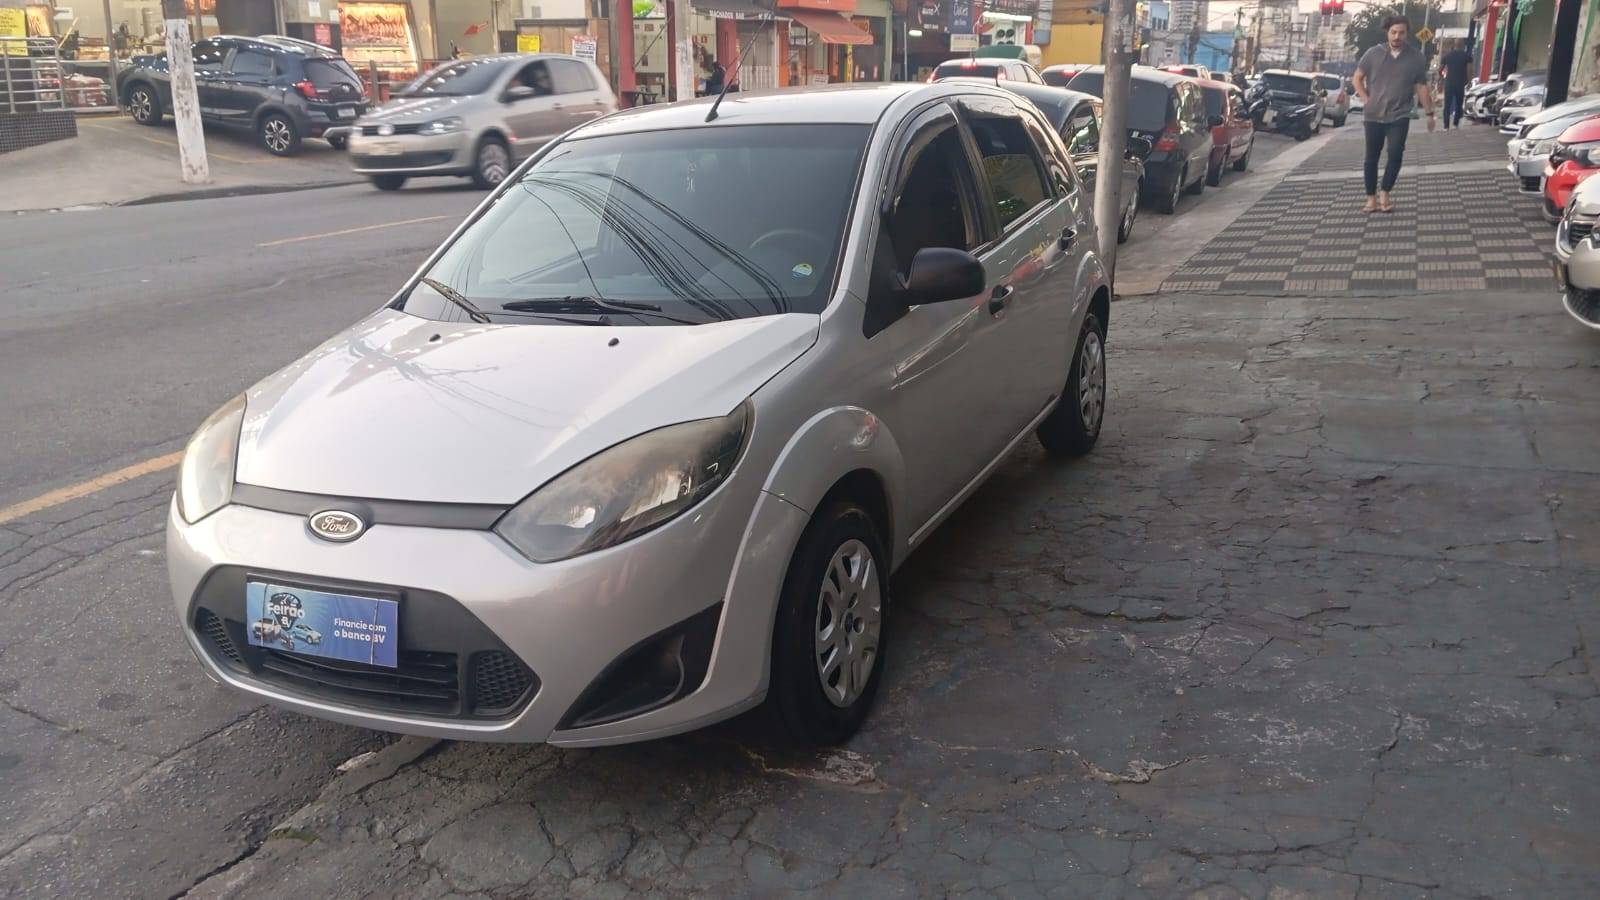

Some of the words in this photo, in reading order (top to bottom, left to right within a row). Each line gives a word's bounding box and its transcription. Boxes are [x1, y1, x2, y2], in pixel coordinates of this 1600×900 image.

[321, 515, 349, 532] Ford
[267, 602, 305, 618] Feirão
[334, 618, 367, 630] Financie
[368, 624, 387, 633] com
[334, 630, 340, 638] o
[341, 630, 370, 642] banco
